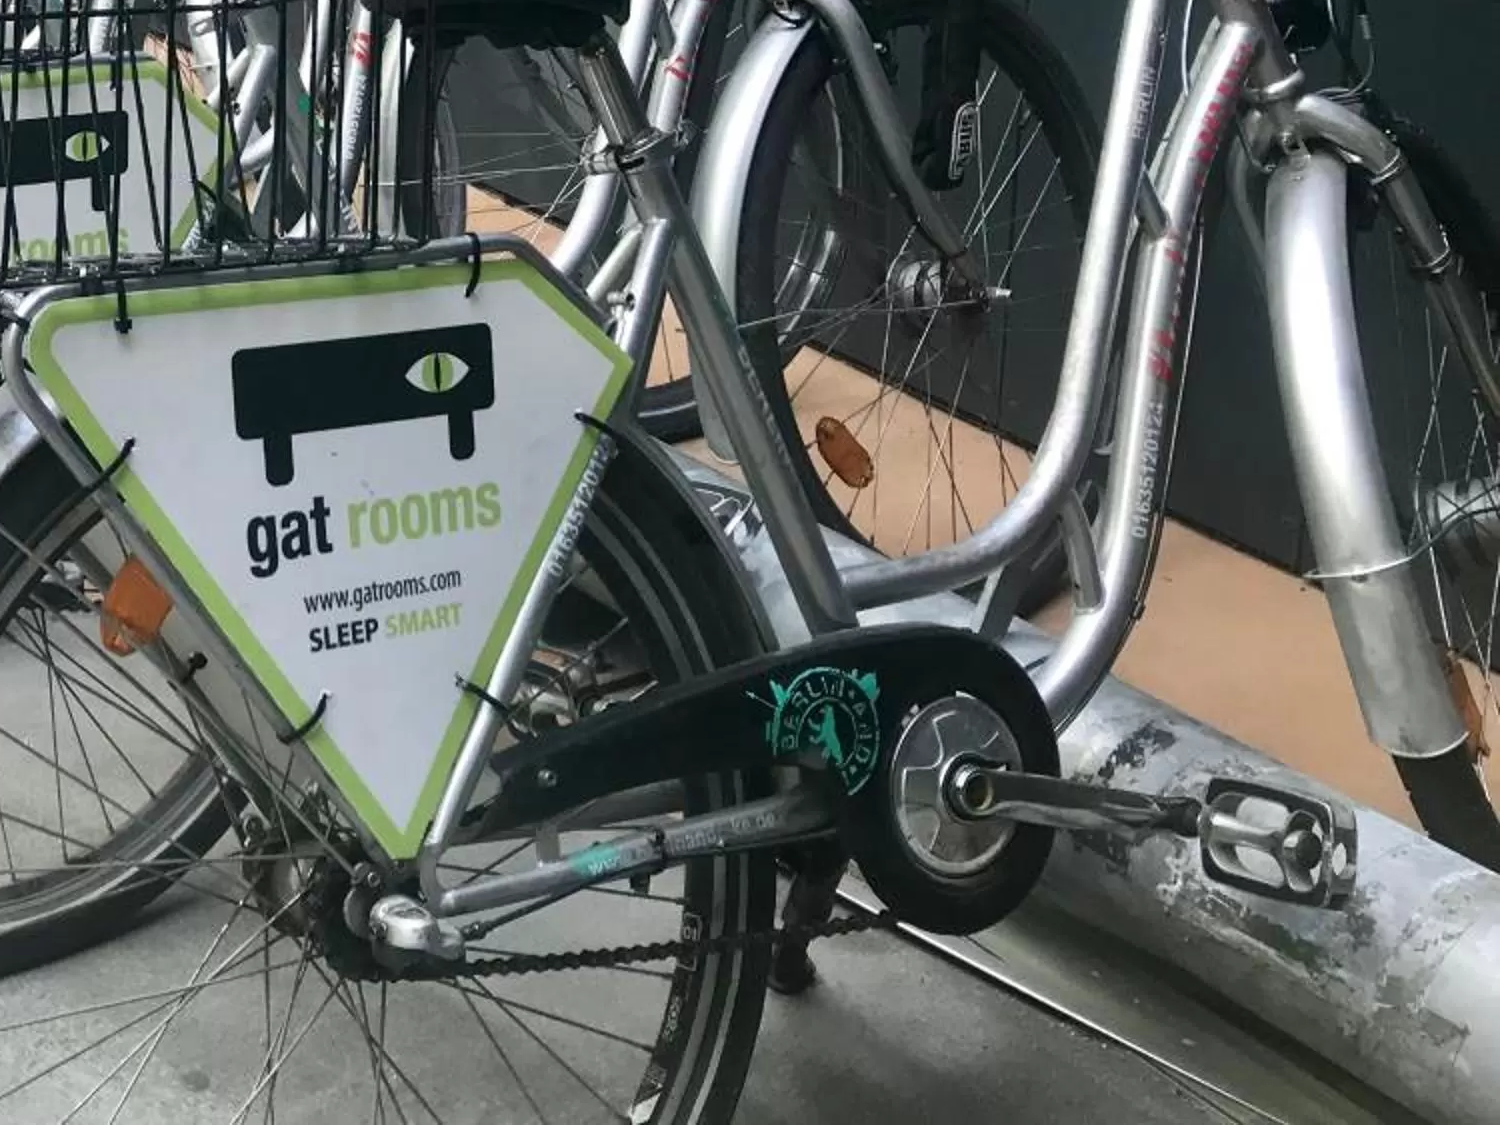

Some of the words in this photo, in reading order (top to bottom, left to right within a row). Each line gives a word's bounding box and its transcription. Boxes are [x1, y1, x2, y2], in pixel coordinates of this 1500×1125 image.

[246, 496, 334, 578] gat
[347, 481, 502, 549] rooms
[303, 570, 462, 614] www.gatrooms.com
[309, 618, 379, 653] SLEEP
[384, 602, 463, 639] SMART
